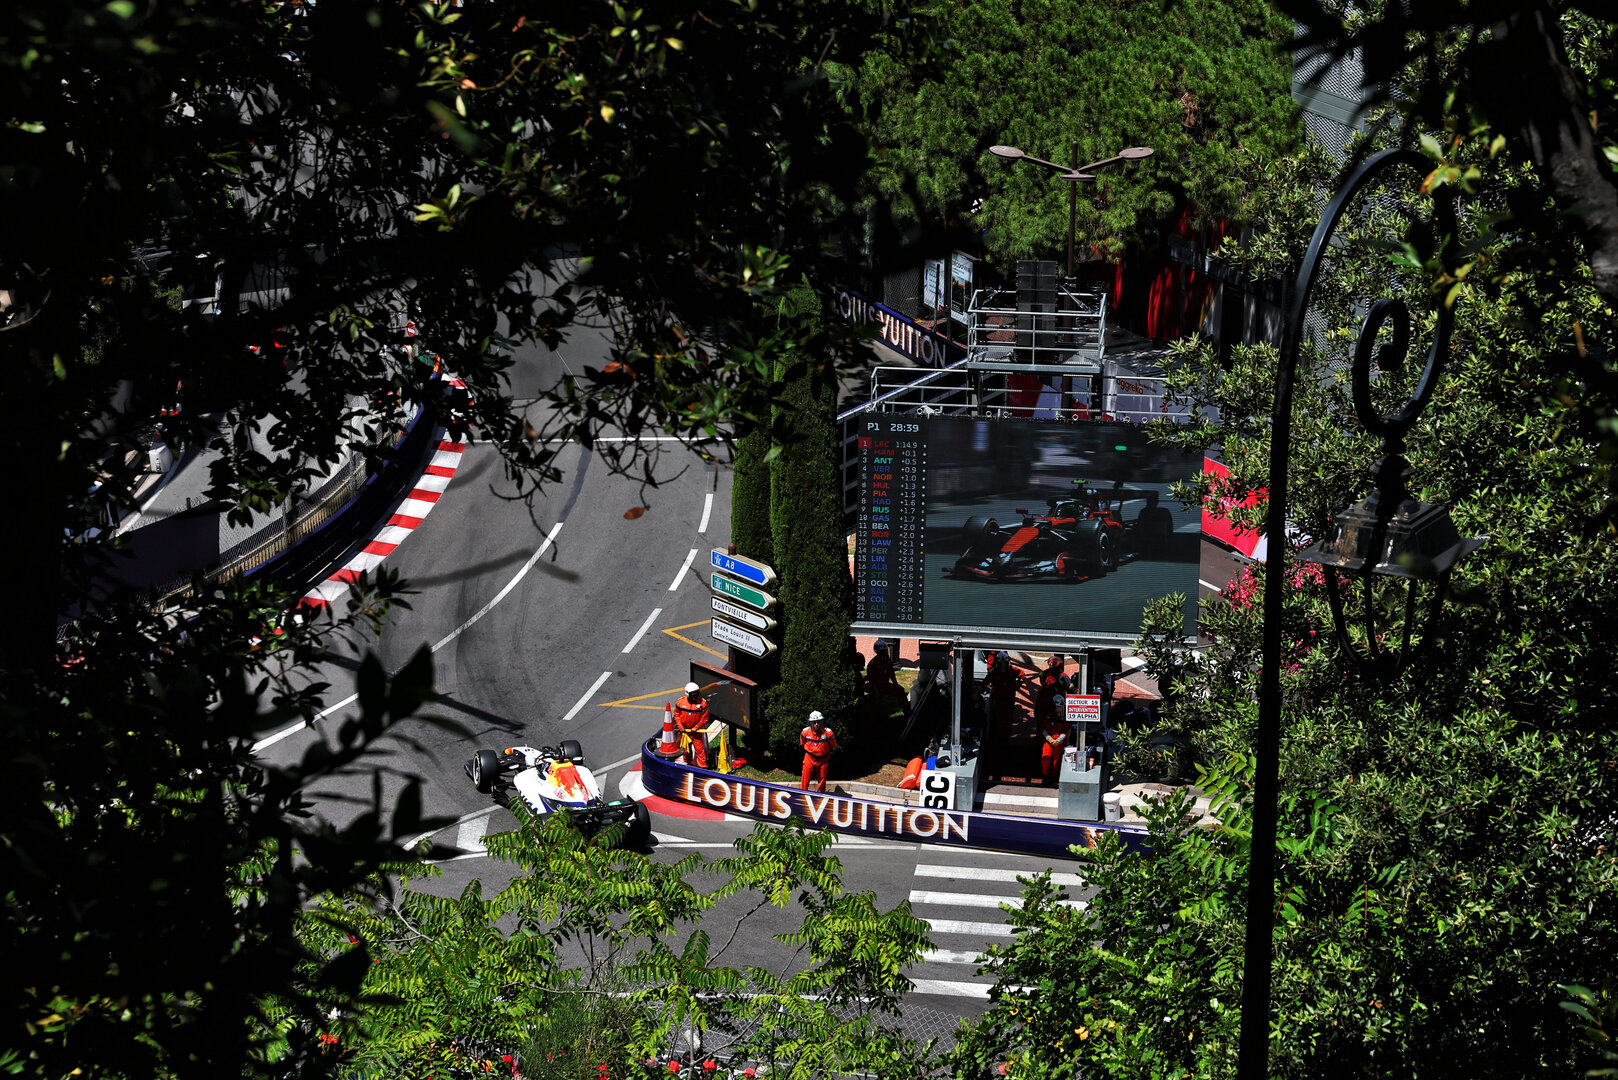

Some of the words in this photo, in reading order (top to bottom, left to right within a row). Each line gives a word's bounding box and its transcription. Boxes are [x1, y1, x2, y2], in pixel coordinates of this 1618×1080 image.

[878, 310, 946, 368] VUITTON
[890, 424, 919, 432] 28:39
[725, 559, 735, 570] A8
[725, 582, 740, 596] NICE
[714, 601, 747, 619] FONTVIEILLE
[714, 622, 729, 632] Stade
[731, 629, 744, 639] Louis
[924, 776, 949, 808] SC
[686, 772, 792, 819] LOUIS
[805, 794, 969, 842] VUITTON
